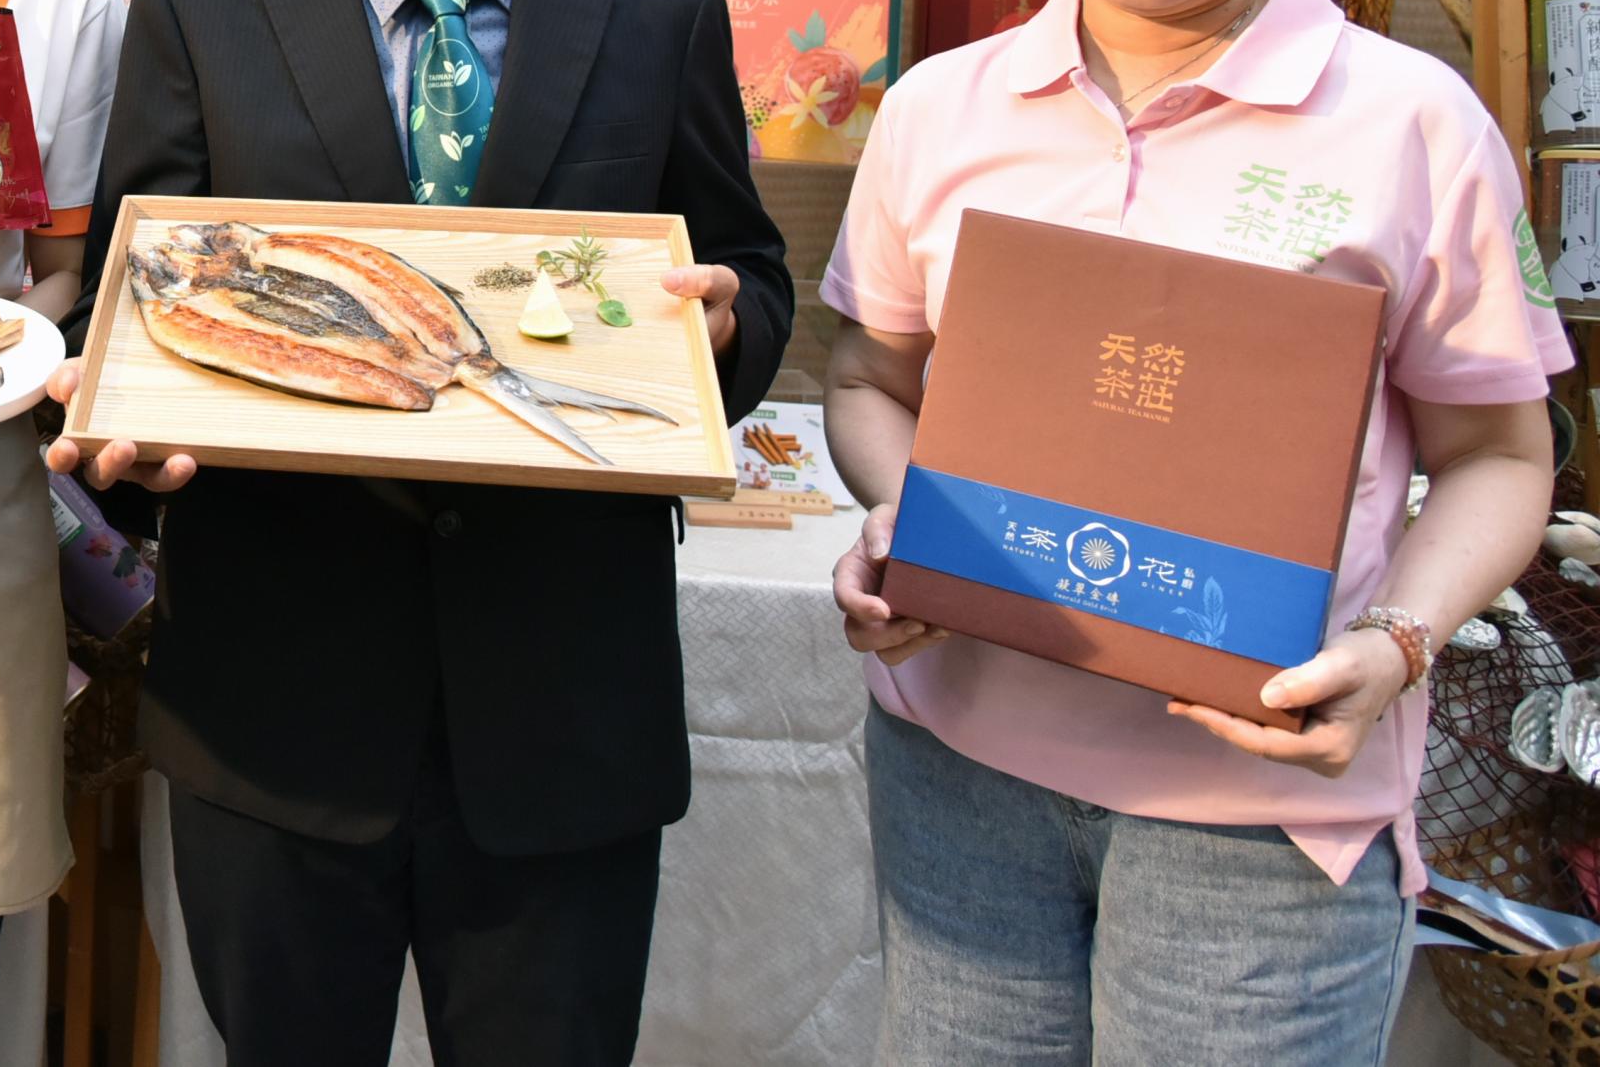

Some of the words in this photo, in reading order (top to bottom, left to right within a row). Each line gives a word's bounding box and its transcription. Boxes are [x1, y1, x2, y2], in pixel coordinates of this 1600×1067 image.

[1234, 163, 1354, 224] 天然
[1224, 201, 1340, 262] 茶莊
[1099, 333, 1185, 375] 天然
[1094, 365, 1178, 413] 茶莊
[1092, 400, 1125, 413] NATURAL
[1128, 408, 1142, 417] TEA
[1004, 521, 1018, 543] 天然
[1020, 526, 1058, 551] 茶
[1002, 544, 1035, 558] NATURE
[1039, 553, 1056, 563] TEA
[1138, 557, 1178, 584] 花
[1141, 581, 1184, 597] DINER
